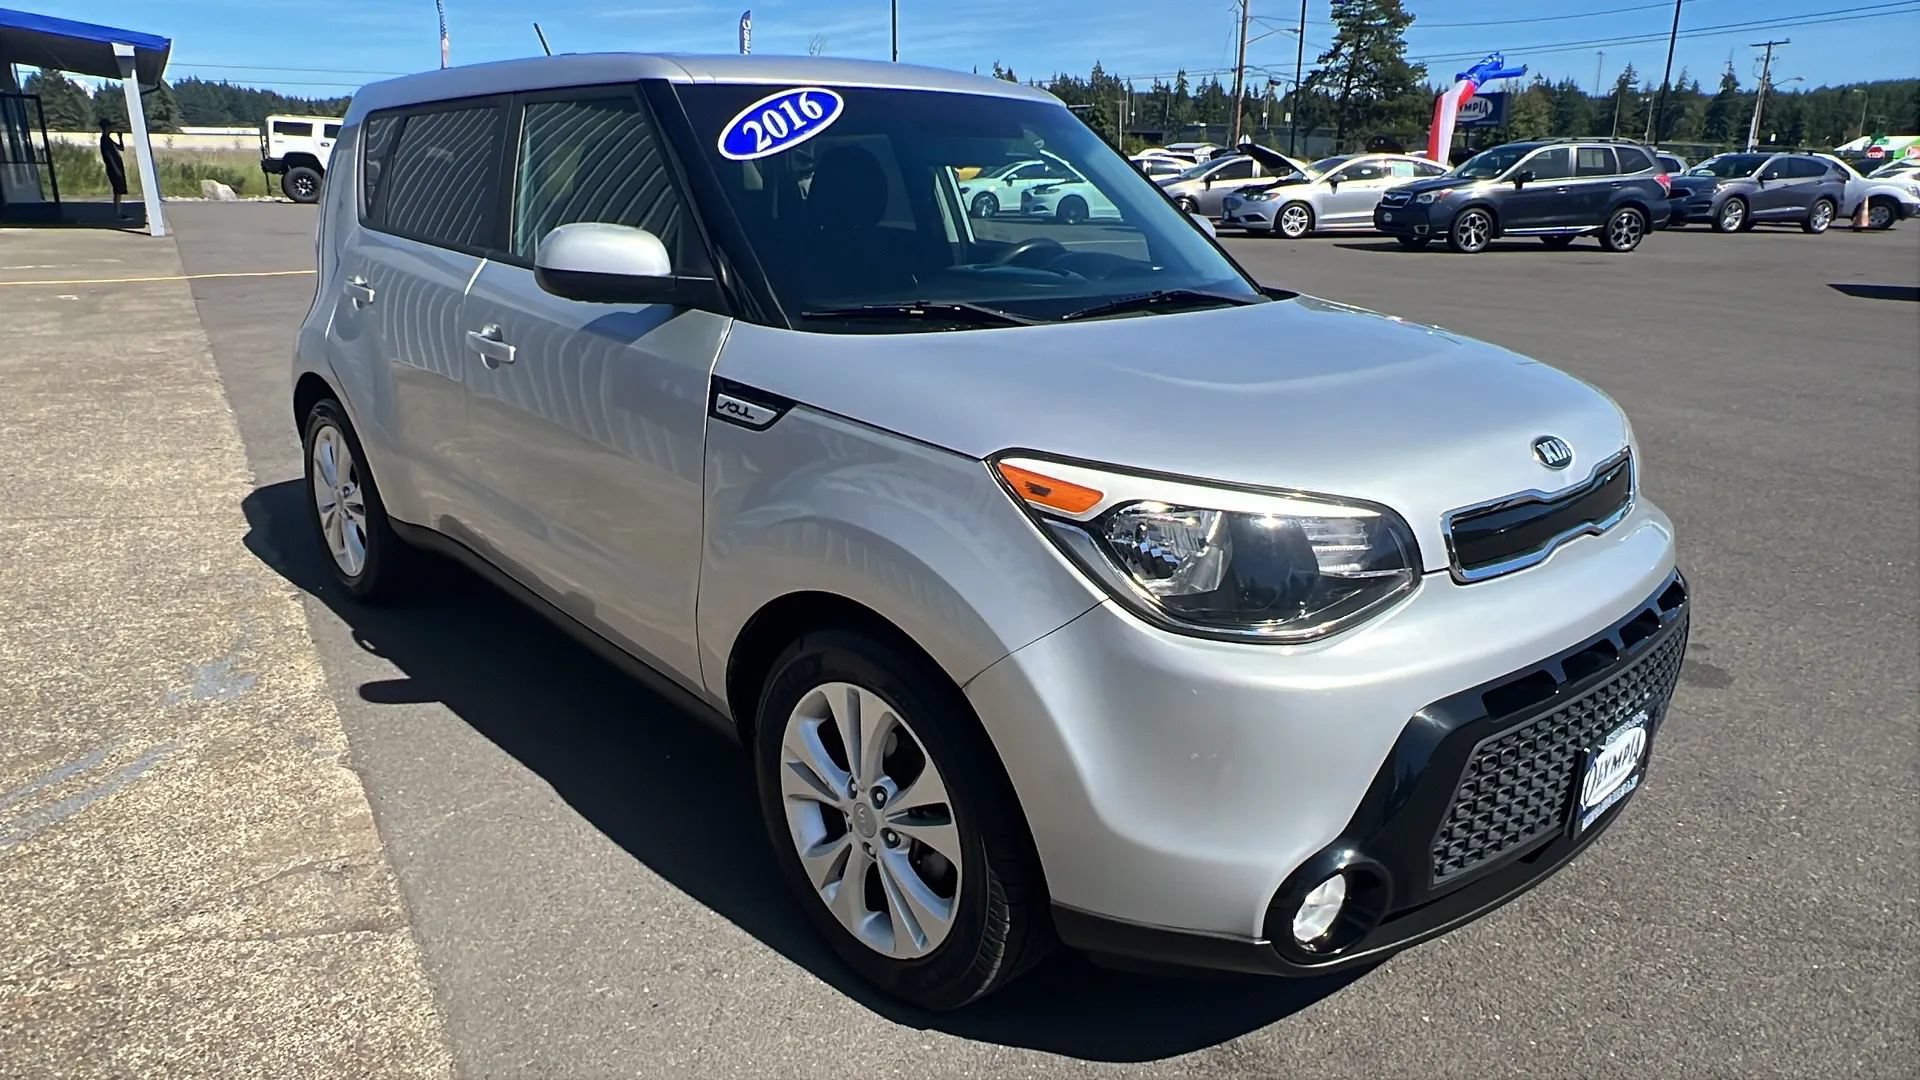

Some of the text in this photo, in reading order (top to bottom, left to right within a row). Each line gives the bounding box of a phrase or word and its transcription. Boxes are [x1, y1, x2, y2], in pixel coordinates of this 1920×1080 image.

[742, 91, 823, 153] 2016
[1536, 439, 1571, 464] KIA
[1583, 729, 1642, 807] OLYMPIA
